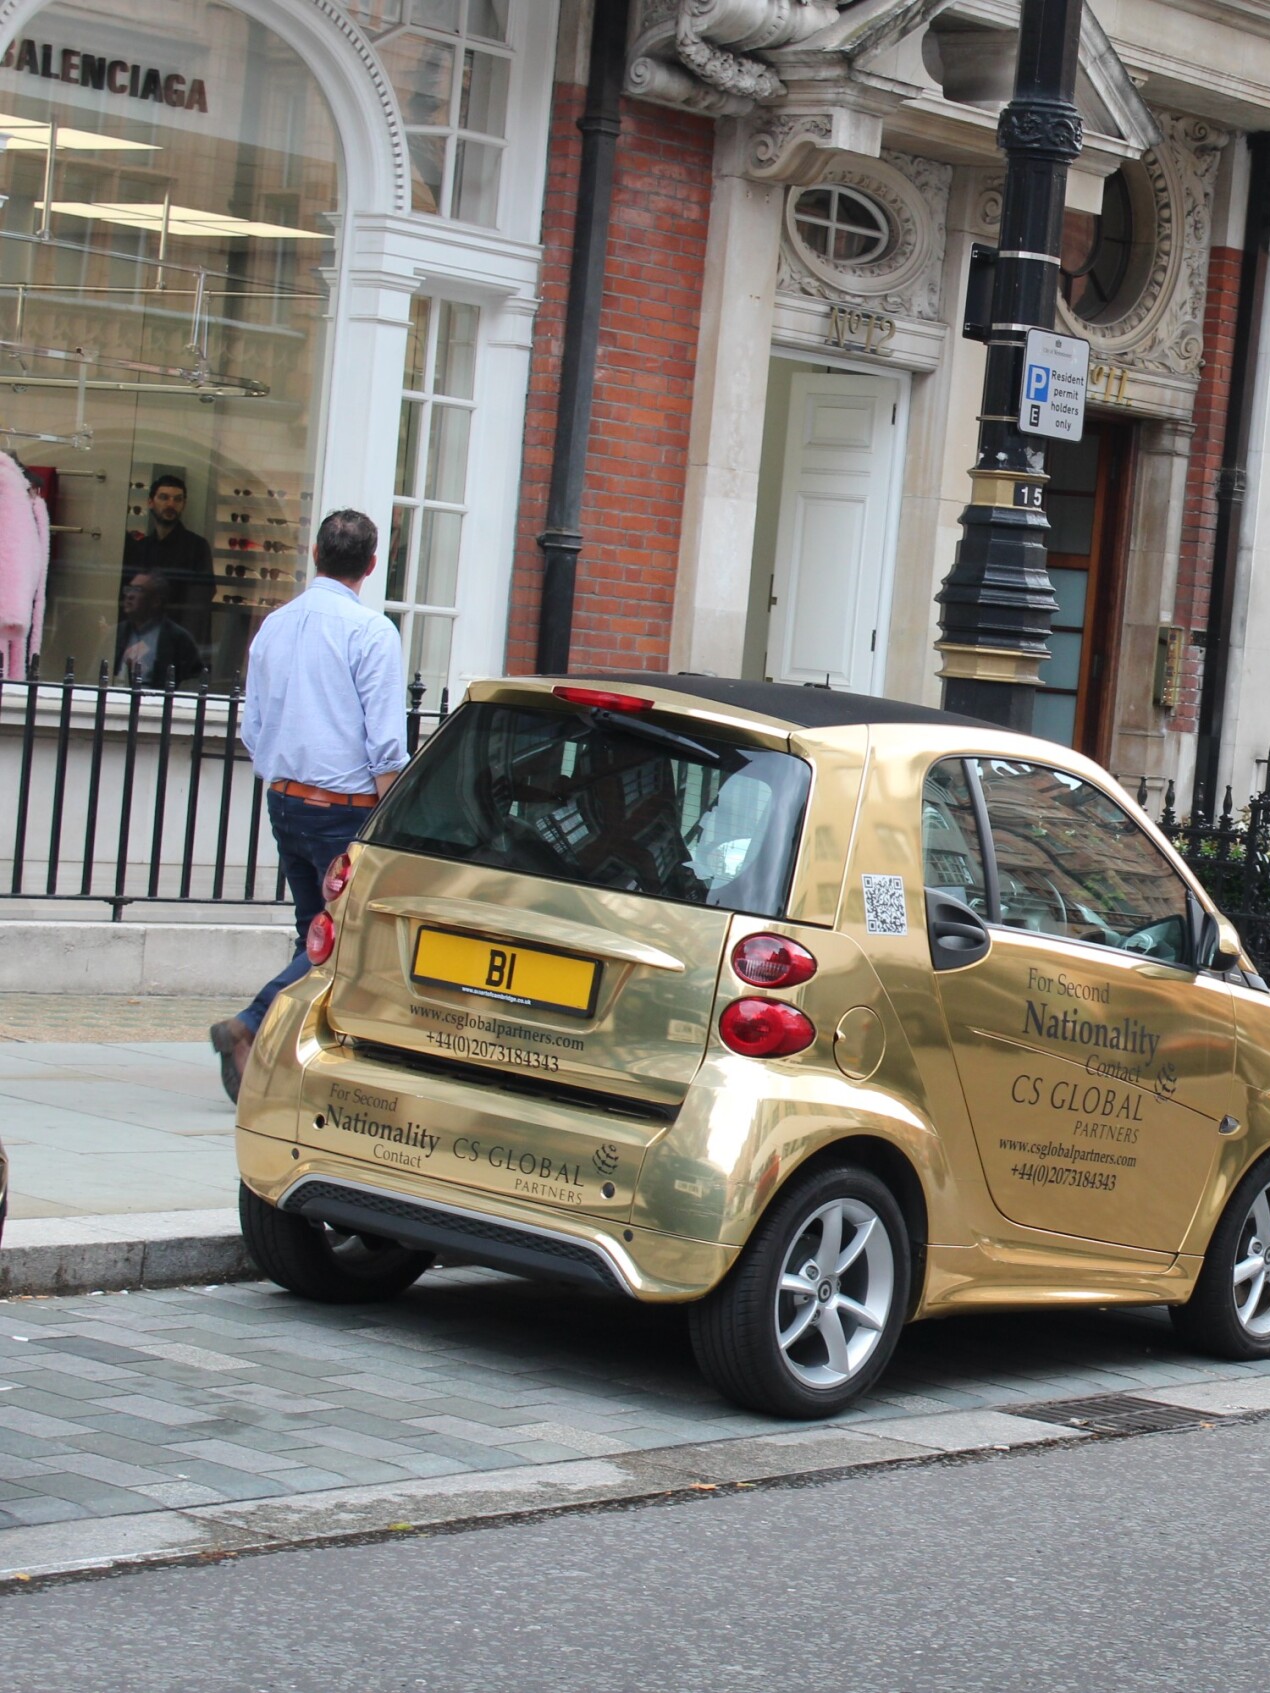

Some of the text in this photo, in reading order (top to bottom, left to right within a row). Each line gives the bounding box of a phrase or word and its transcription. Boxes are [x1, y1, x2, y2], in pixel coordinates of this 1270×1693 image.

[1029, 366, 1047, 399] P
[1051, 370, 1084, 386] Resident
[1050, 401, 1079, 416] holders
[1053, 388, 1078, 401] permit
[1031, 407, 1039, 424] E
[1055, 419, 1072, 431] only
[1021, 486, 1043, 506] 15
[1027, 967, 1110, 1004] For Second
[410, 1003, 585, 1051] www.csglobalpartners.com
[1022, 999, 1161, 1067] Nationality
[426, 1031, 559, 1073] +44(0)2073184343
[1085, 1053, 1142, 1083] Contact
[329, 1083, 398, 1113] For Second
[1011, 1074, 1143, 1121] CS GLOBAL
[324, 1103, 441, 1158] Nationality
[1073, 1120, 1140, 1144] PARTNERS
[373, 1143, 422, 1169] Contact
[452, 1137, 585, 1188] CS GLOBAL
[999, 1137, 1137, 1167] www.csglobalpartners.com
[514, 1178, 583, 1206] PARTNERS
[1011, 1163, 1117, 1191] +44(0)2073184343
